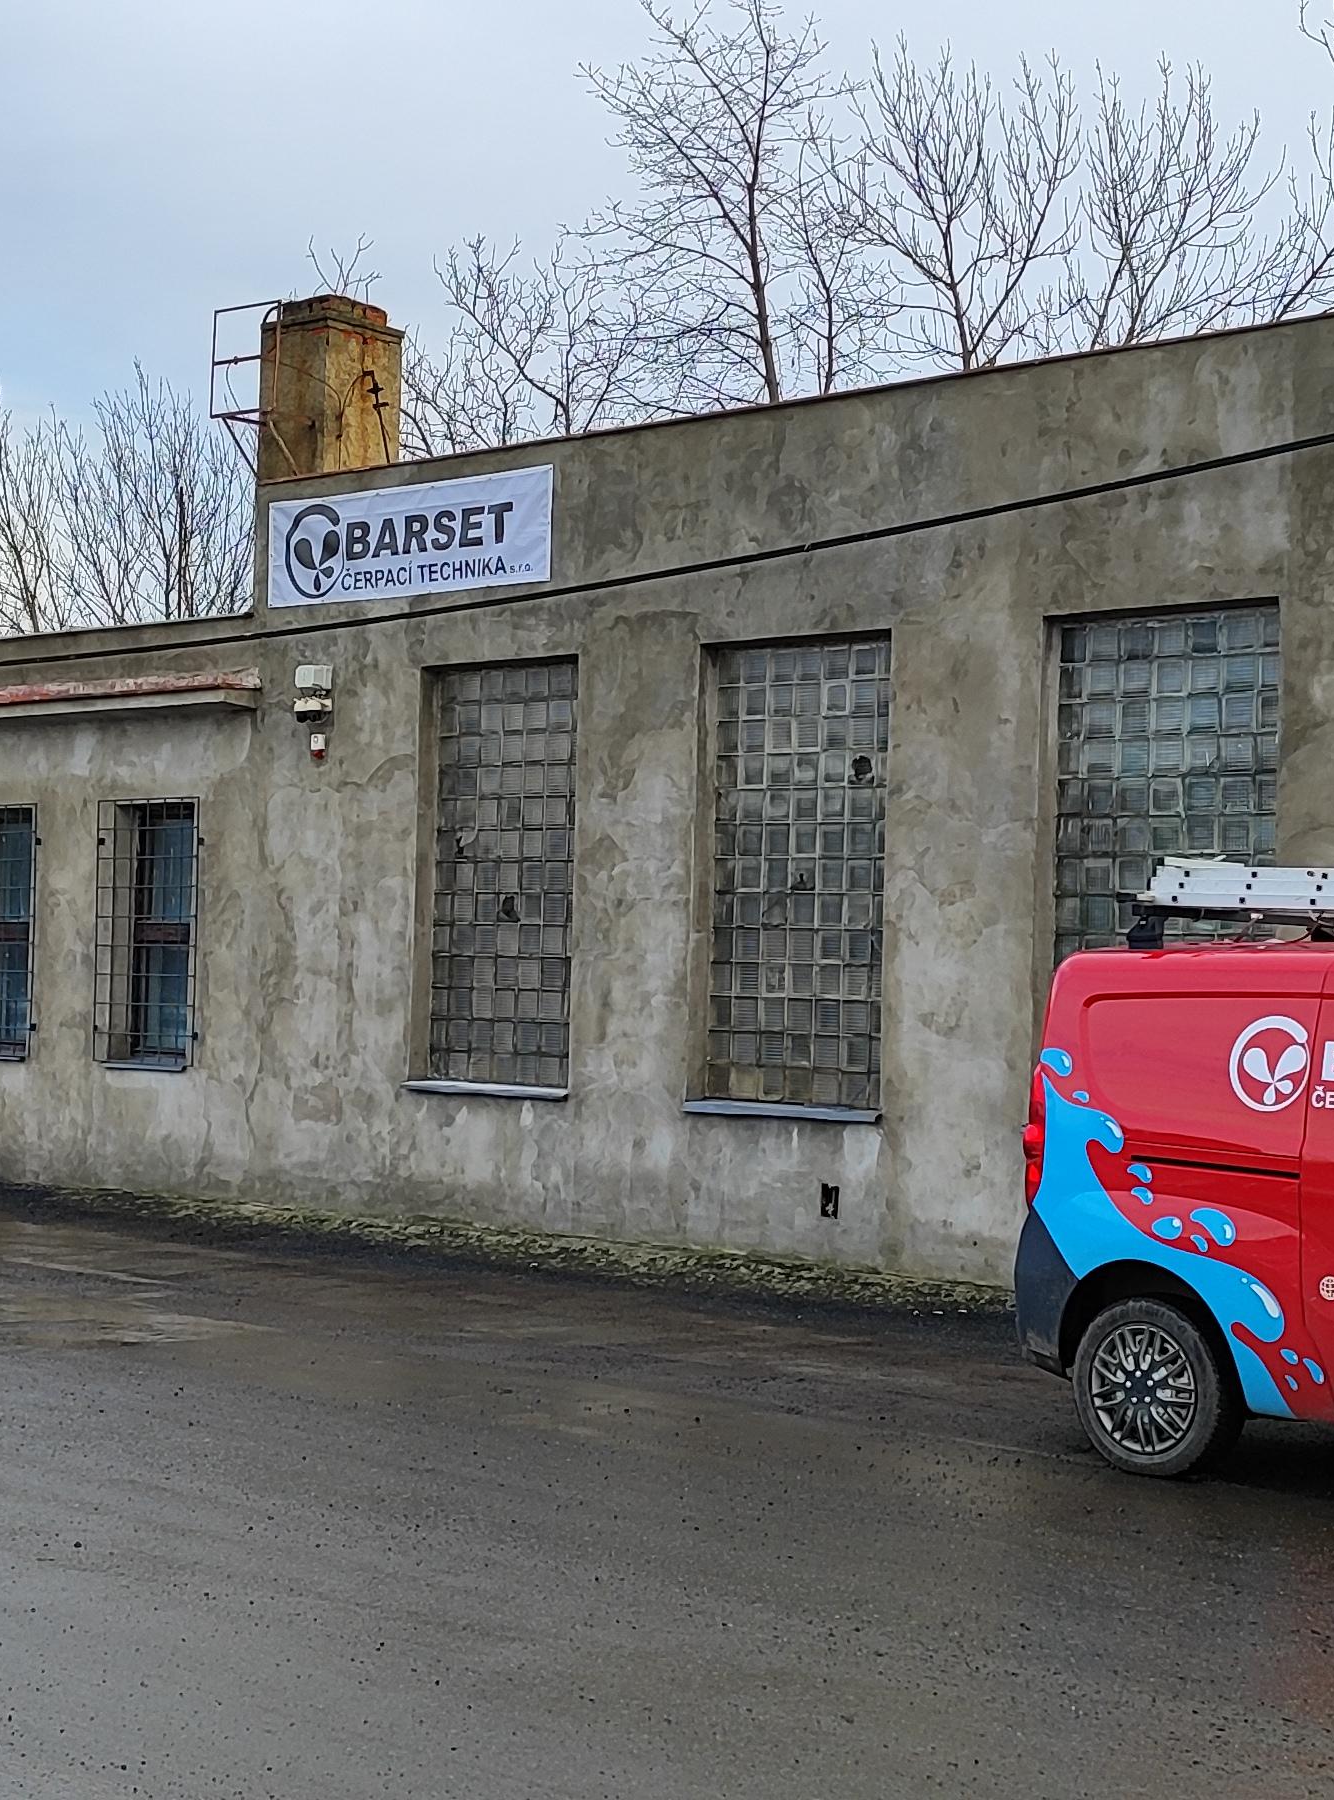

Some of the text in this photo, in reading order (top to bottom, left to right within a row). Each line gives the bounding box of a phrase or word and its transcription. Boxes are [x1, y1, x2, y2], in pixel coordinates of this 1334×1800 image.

[345, 502, 513, 561] BARSET
[341, 556, 534, 592] ČERPACÍ TECHNIKA s.r.o.
